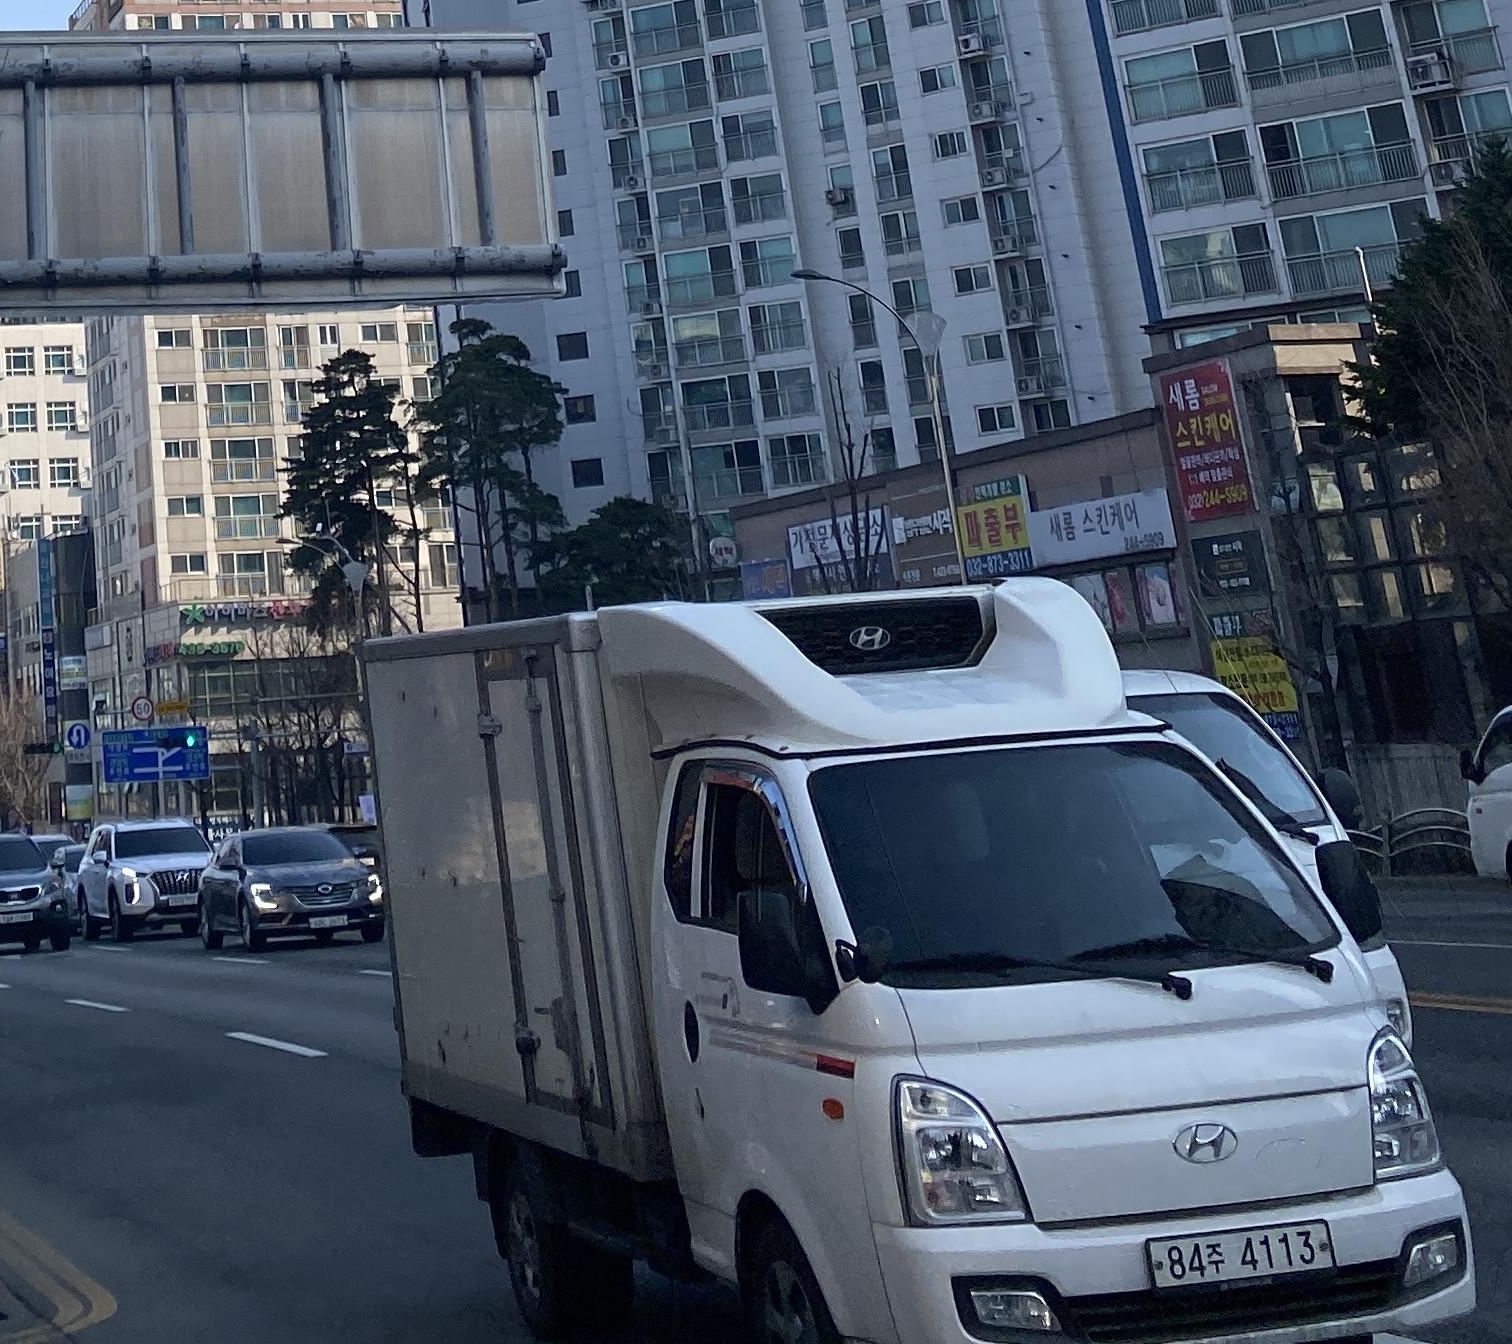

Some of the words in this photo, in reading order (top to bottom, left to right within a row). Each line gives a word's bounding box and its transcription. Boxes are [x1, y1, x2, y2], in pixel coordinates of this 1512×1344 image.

[1169, 379, 1201, 412] 새롬
[1175, 409, 1237, 448] 스킨케어
[1049, 510, 1078, 543] 새롬
[1082, 498, 1140, 534] 스킨케어
[966, 552, 1032, 577] 032-873-3311
[1167, 1241, 1225, 1281] 84주
[1240, 1230, 1316, 1272] 4113
